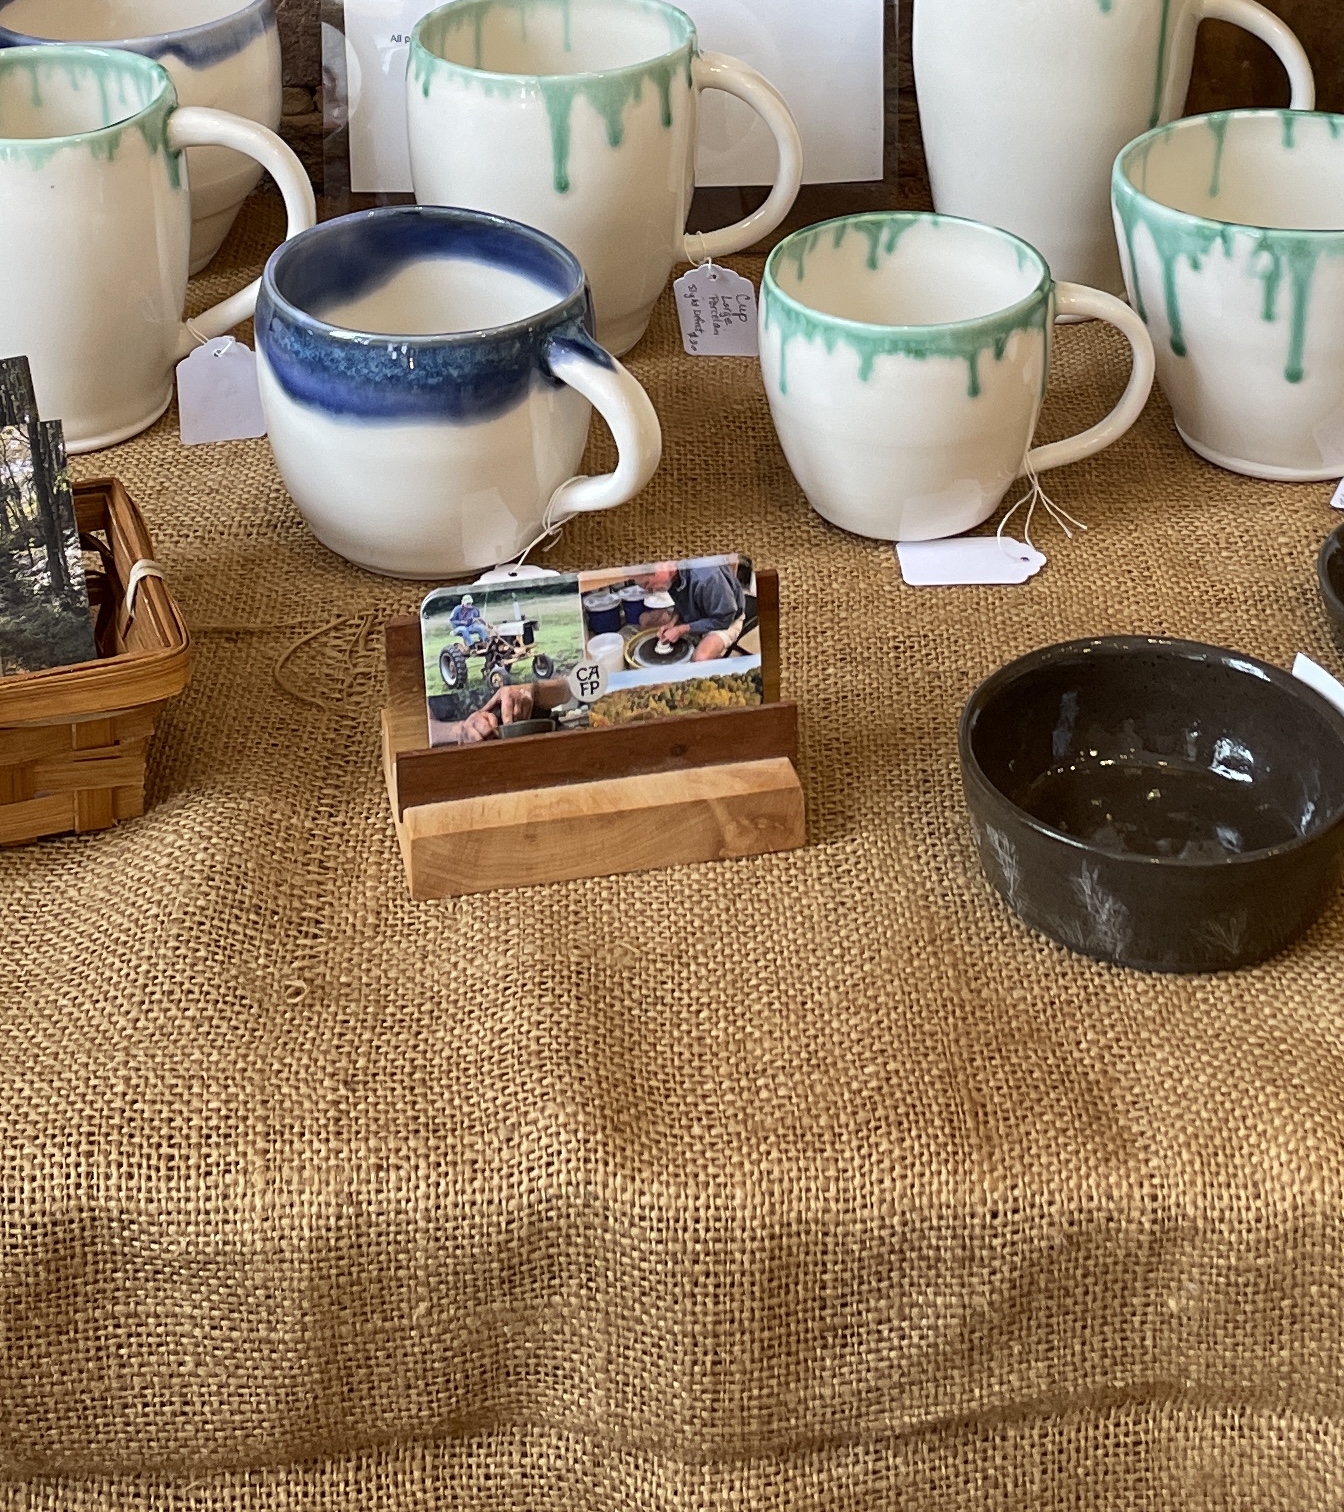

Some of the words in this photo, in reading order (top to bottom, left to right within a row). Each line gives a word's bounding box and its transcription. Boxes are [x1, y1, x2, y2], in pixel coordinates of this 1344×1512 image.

[390, 34, 402, 43] All
[718, 296, 733, 326] Large
[731, 294, 751, 323] Cup
[576, 664, 600, 682] CA
[579, 680, 600, 697] FP
